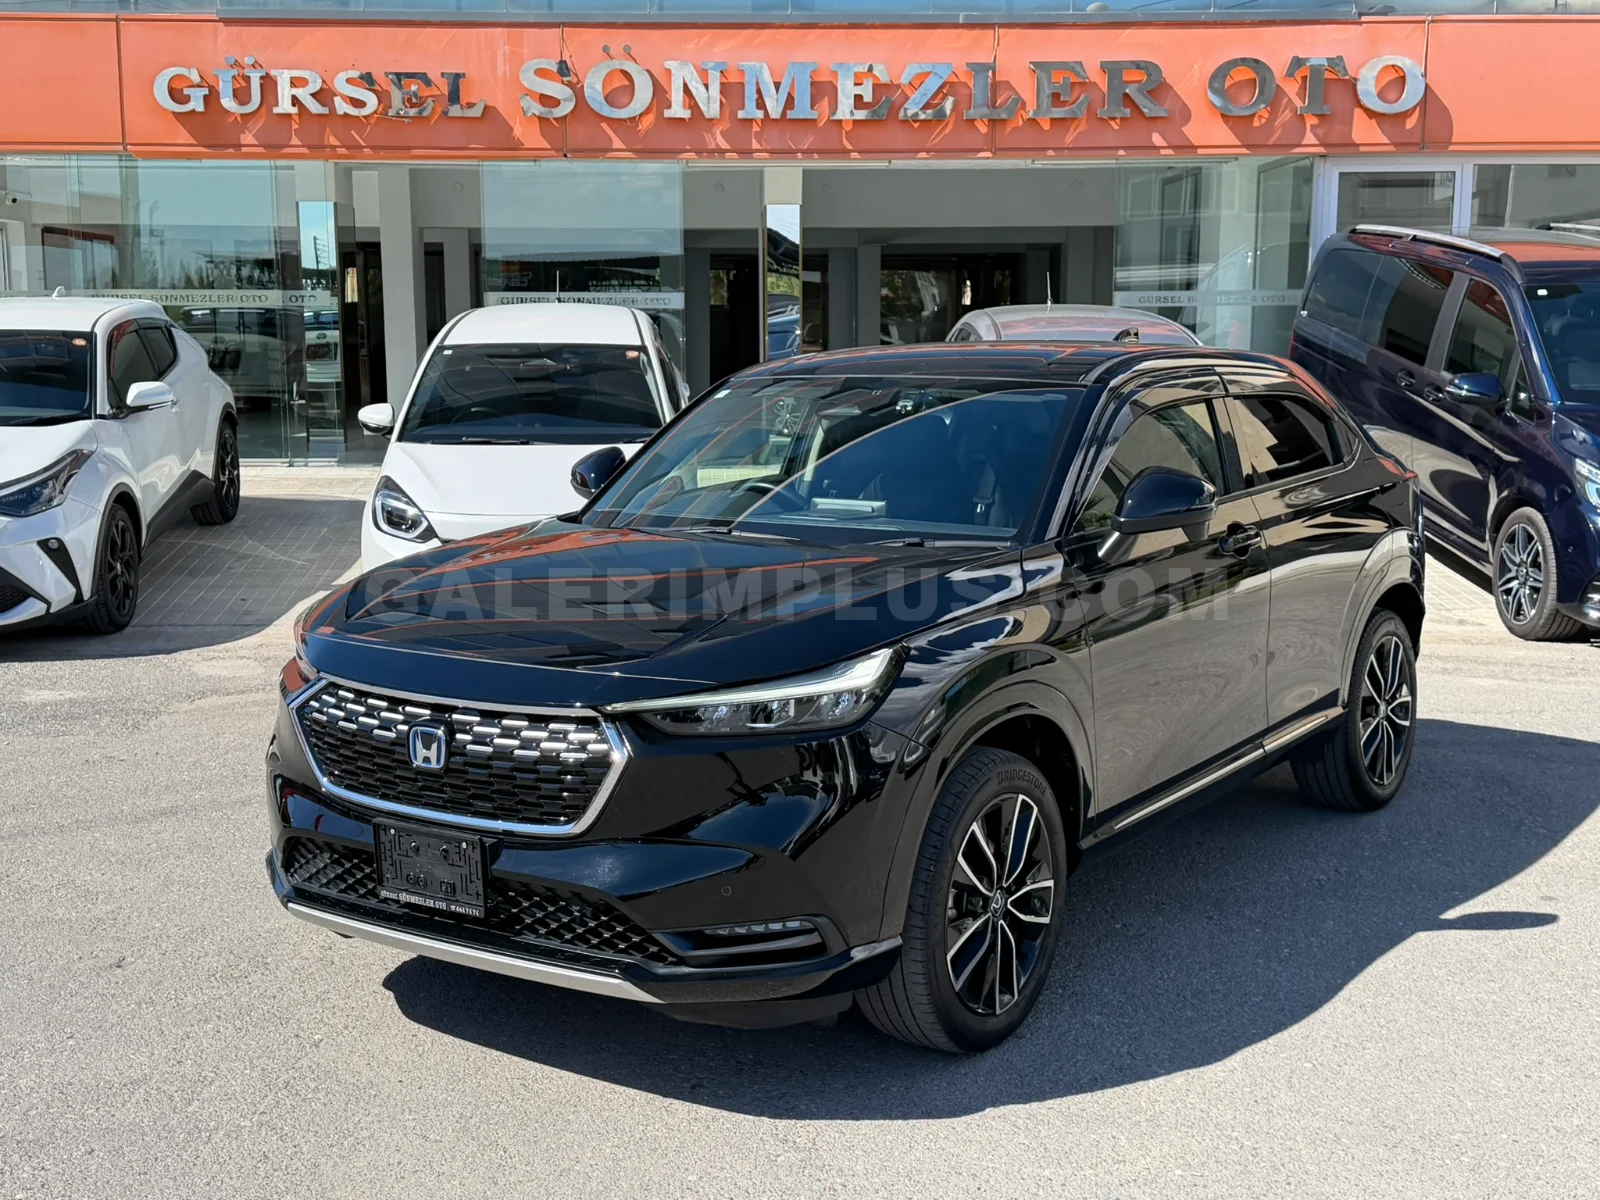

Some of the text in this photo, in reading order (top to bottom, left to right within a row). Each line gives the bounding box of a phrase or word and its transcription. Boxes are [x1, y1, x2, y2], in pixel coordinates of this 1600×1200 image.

[153, 44, 1425, 122] GÜRSEL SÖNMEZLER OTO
[239, 293, 268, 303] OTO
[996, 768, 1047, 797] BRIDGESTONE
[435, 901, 447, 910] OTO
